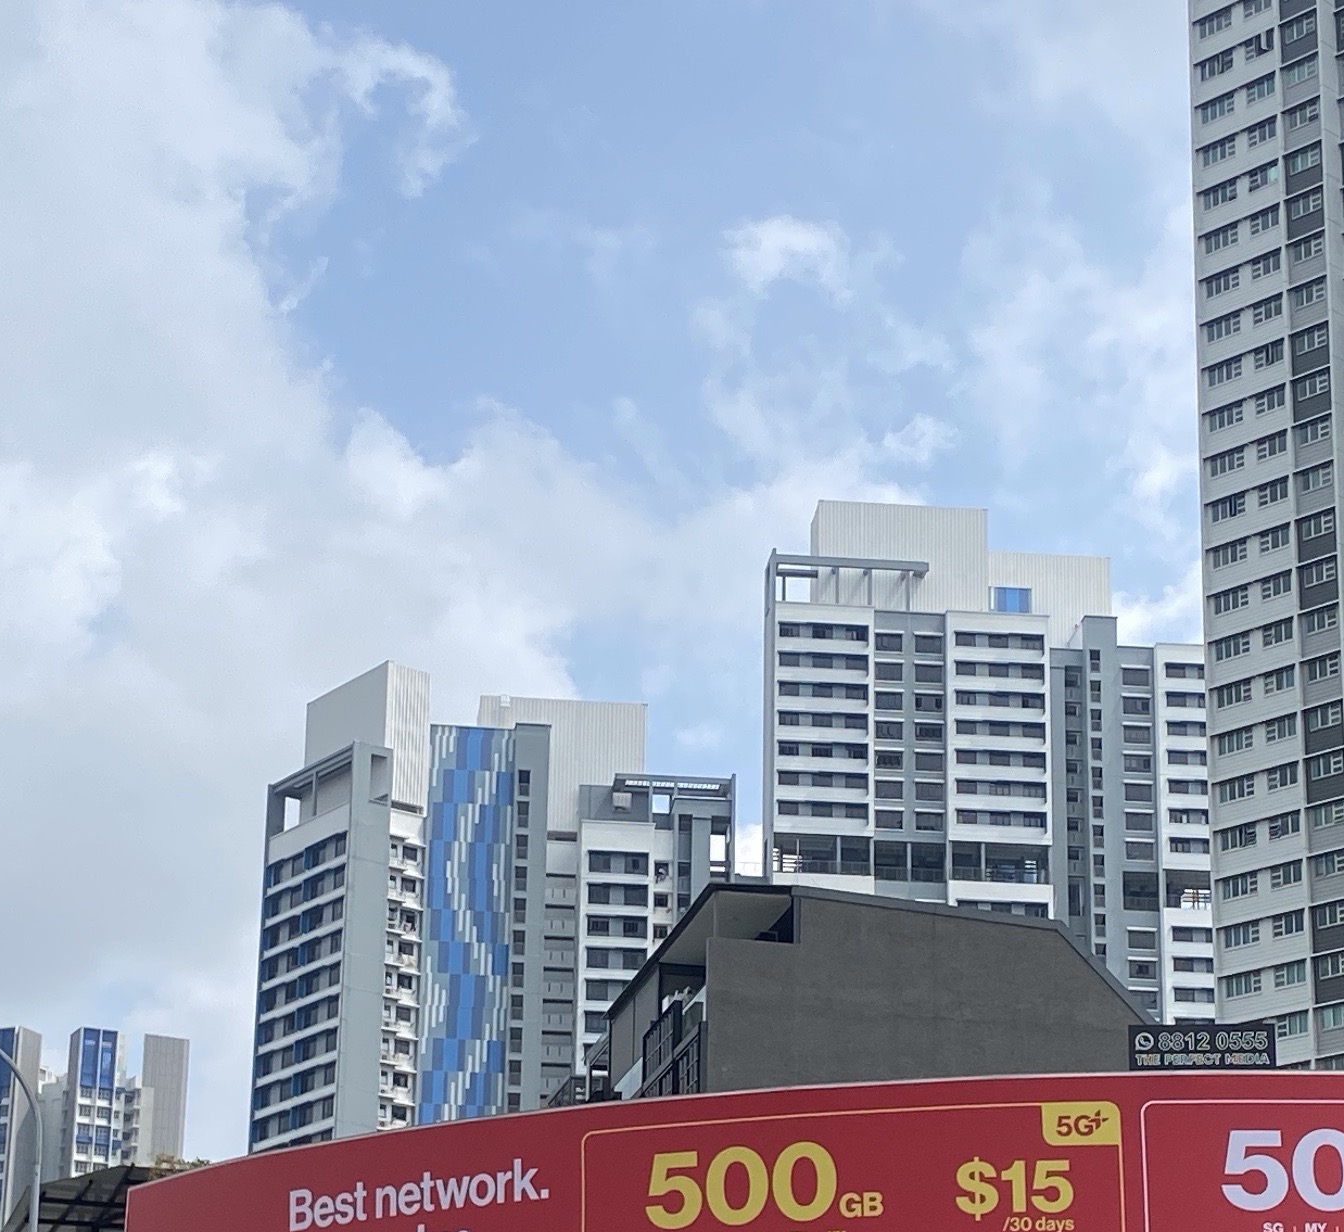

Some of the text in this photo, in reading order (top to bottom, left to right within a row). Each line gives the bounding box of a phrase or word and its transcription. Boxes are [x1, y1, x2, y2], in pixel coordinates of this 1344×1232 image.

[1135, 1052, 1270, 1066] THE PERFECT MEDIA
[1158, 1031, 1268, 1051] 8812 0555
[288, 1157, 550, 1232] Best network.
[645, 1141, 884, 1230] 500 GB
[955, 1156, 1075, 1221] $15
[1003, 1217, 1032, 1232] /30
